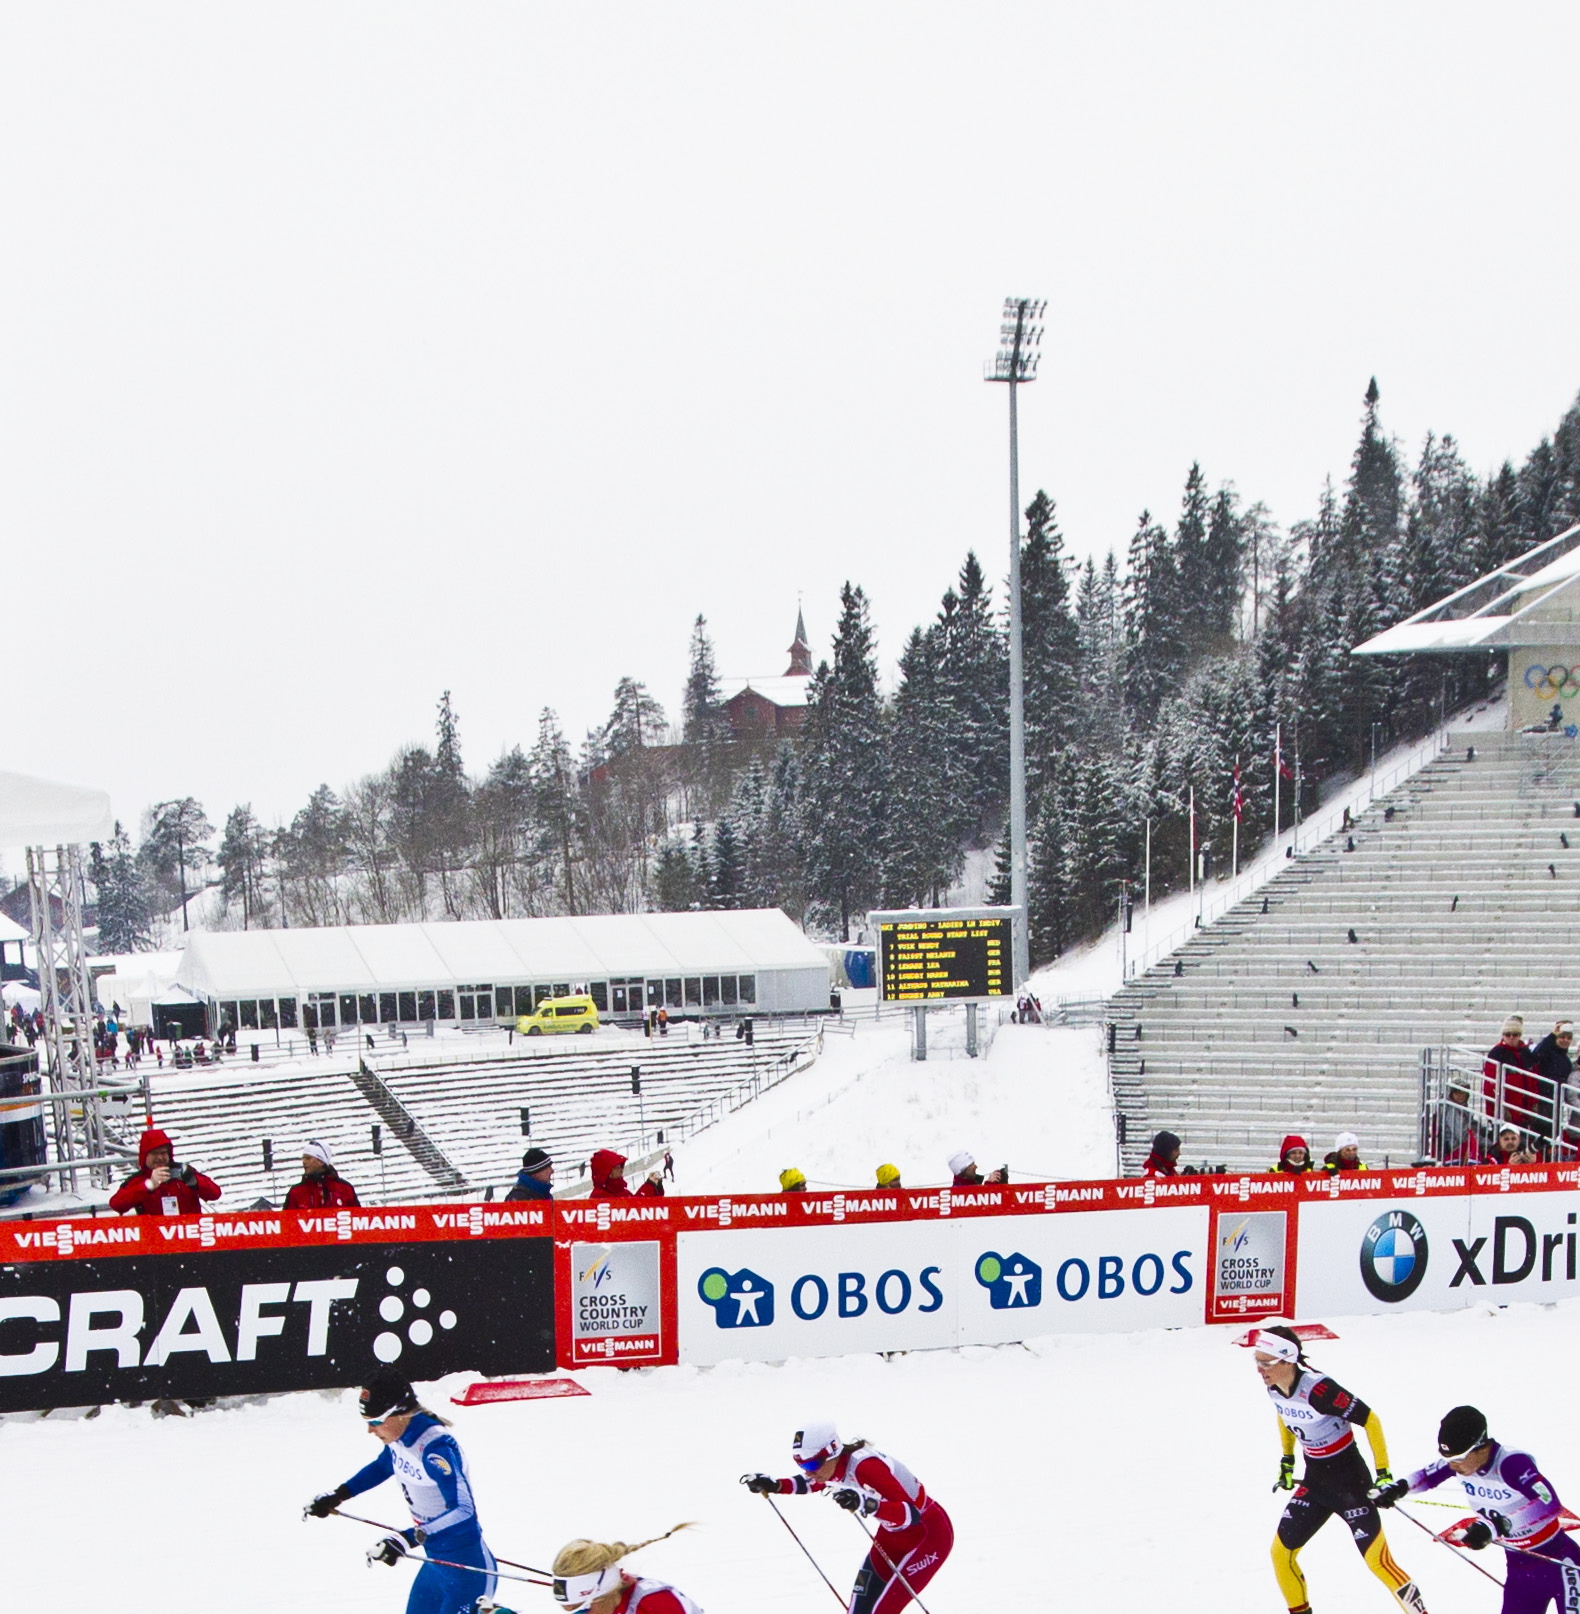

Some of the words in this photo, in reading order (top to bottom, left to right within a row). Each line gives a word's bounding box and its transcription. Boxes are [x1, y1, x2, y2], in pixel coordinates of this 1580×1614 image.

[1116, 1179, 1202, 1205] VIESSMANN
[1212, 1177, 1295, 1201] VIESSMANN
[1305, 1174, 1381, 1199] VIESSMANN
[1392, 1171, 1465, 1195] VIESSMANN
[1476, 1168, 1548, 1192] VIESSMANN
[802, 1194, 897, 1222] VIESSMANN
[909, 1189, 1002, 1216] VIESSMANN
[1015, 1184, 1104, 1211] VIESSMANN
[432, 1206, 543, 1236] VIESSMANN
[561, 1202, 669, 1231] VIESSMANN
[684, 1199, 787, 1225] VIESSMANN
[159, 1217, 281, 1247] VIESSMANN
[298, 1210, 416, 1241] VIESSMANN
[1368, 1212, 1426, 1243] BMW
[14, 1224, 140, 1255] VIESSMANN
[1056, 1250, 1193, 1302] OBOS
[1221, 1257, 1260, 1270] CROSS
[1221, 1266, 1276, 1282] COUNTRY
[791, 1266, 943, 1321] OBOS
[1220, 1278, 1248, 1291] WORLD
[1251, 1277, 1272, 1290] CUP
[579, 1293, 626, 1309] CROSS
[580, 1303, 648, 1320] COUNTRY
[1220, 1294, 1279, 1313] VIESSMANN
[0, 1278, 359, 1377] CRAFT
[579, 1318, 612, 1332] WORLD
[616, 1317, 645, 1331] CUP
[580, 1337, 655, 1358] VIESSMANN
[1284, 1407, 1314, 1420] OBOS
[1477, 1487, 1512, 1501] OBOS
[1413, 1598, 1426, 1613] 12
